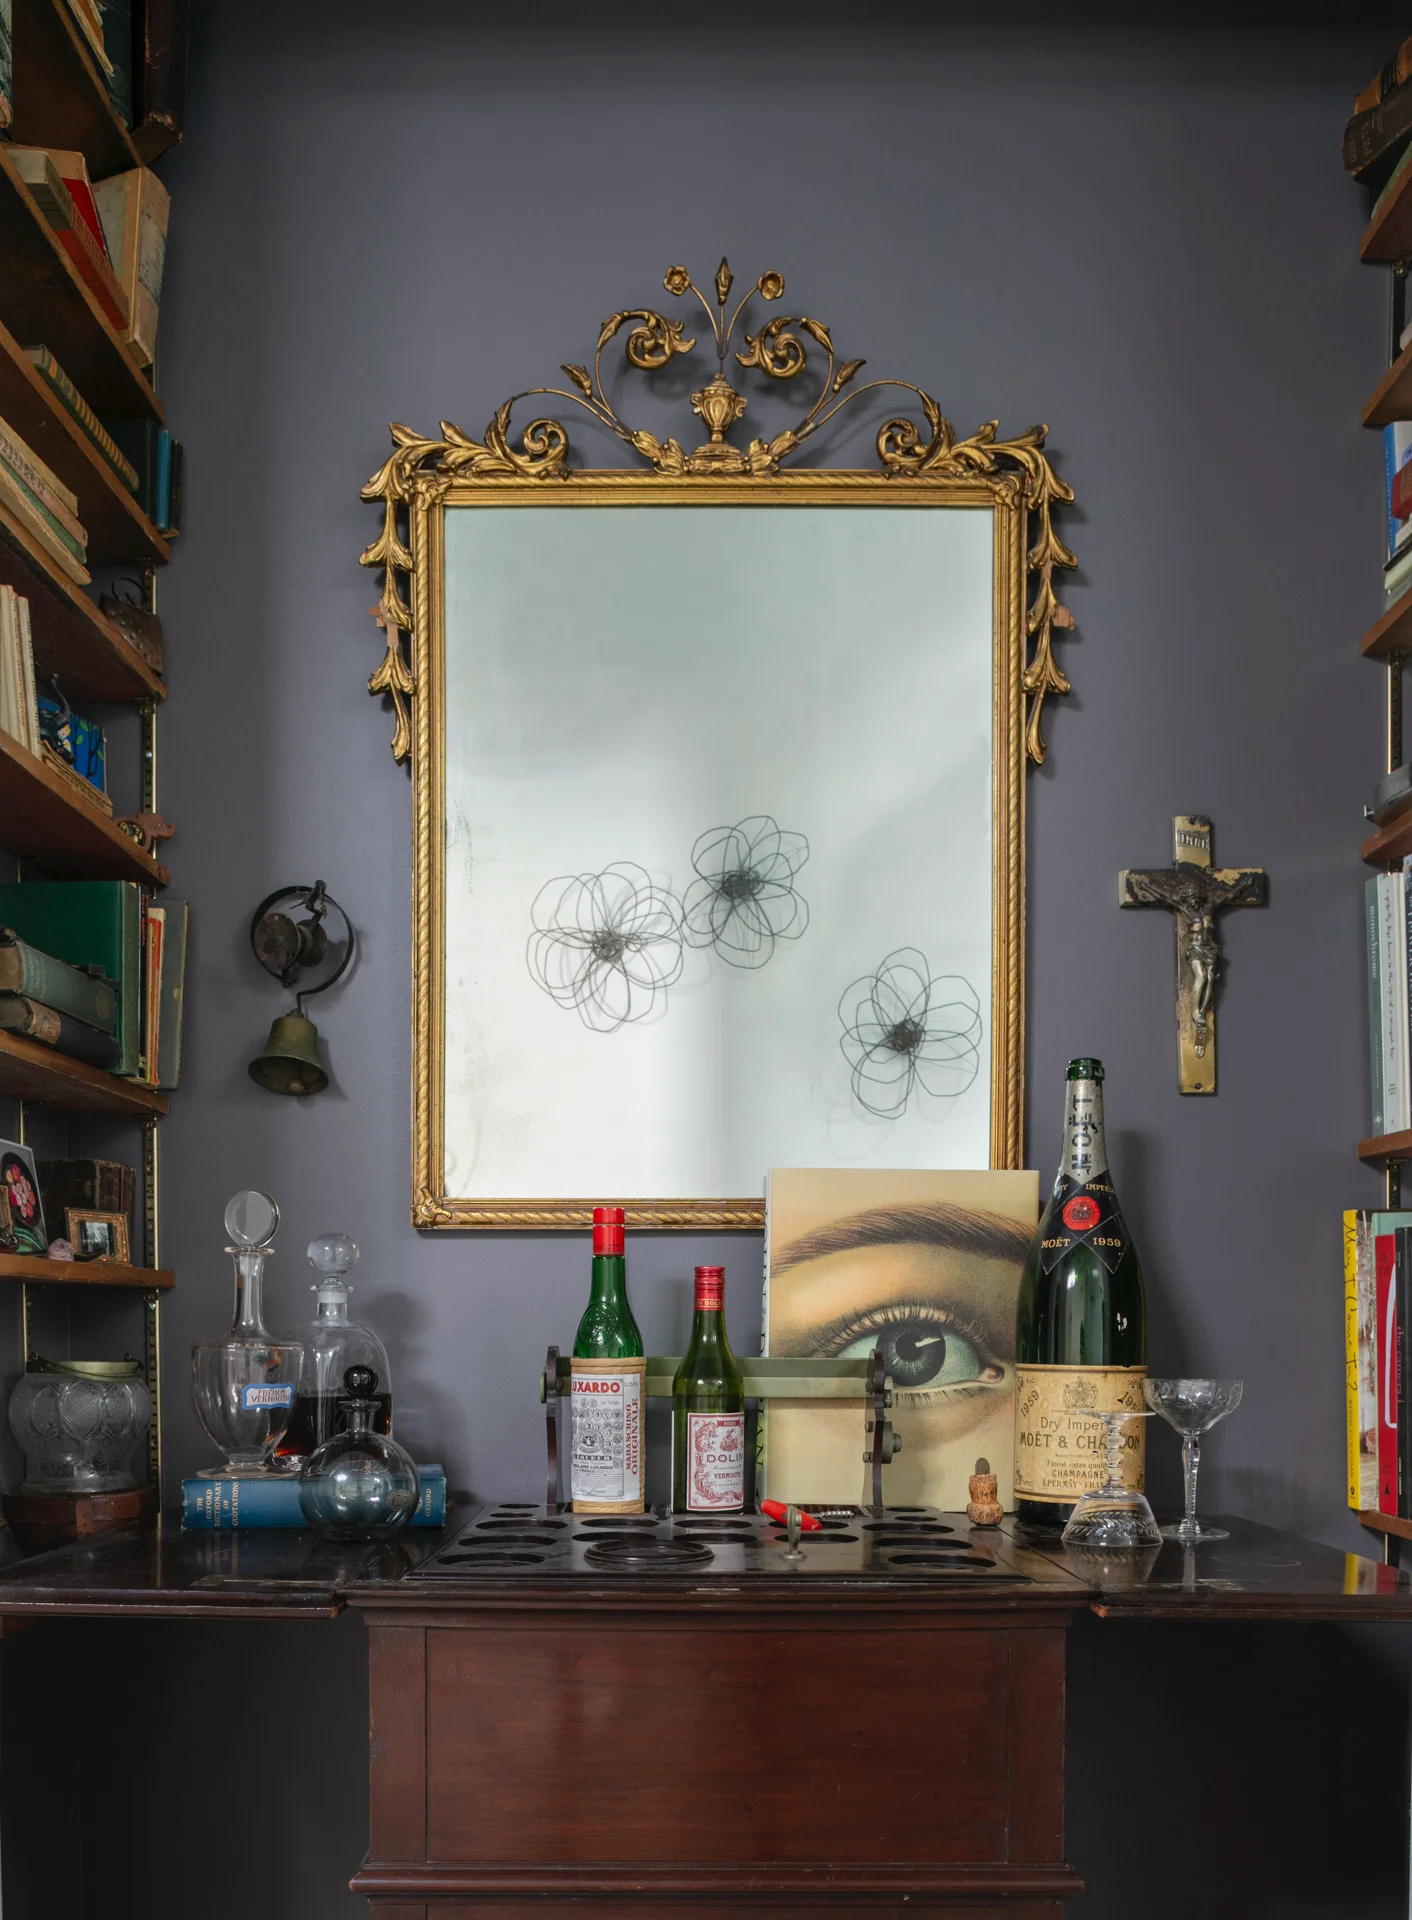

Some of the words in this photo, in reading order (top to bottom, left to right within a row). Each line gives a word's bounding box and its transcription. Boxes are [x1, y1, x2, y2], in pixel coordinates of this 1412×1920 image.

[1181, 833, 1205, 848] INRI
[1369, 904, 1378, 978] monochrome
[1068, 1094, 1092, 1170] MOËT
[1093, 1236, 1121, 1247] 1959
[1344, 1218, 1357, 1270] May
[1345, 1295, 1357, 1350] Come
[1346, 1353, 1358, 1391] In?
[251, 1394, 290, 1403] VERMOUTH
[258, 1389, 285, 1397] FRENCH
[1020, 1390, 1039, 1417] 1959
[1040, 1416, 1061, 1432] Dry
[631, 1397, 639, 1475] ORIGINALE
[1058, 1436, 1068, 1448] &
[706, 1453, 743, 1462] DOLIN
[1047, 1459, 1066, 1467] Finest
[1088, 1461, 1108, 1470] qualit
[1052, 1469, 1104, 1479] CHAMPAGNE
[223, 1499, 229, 1510] OF
